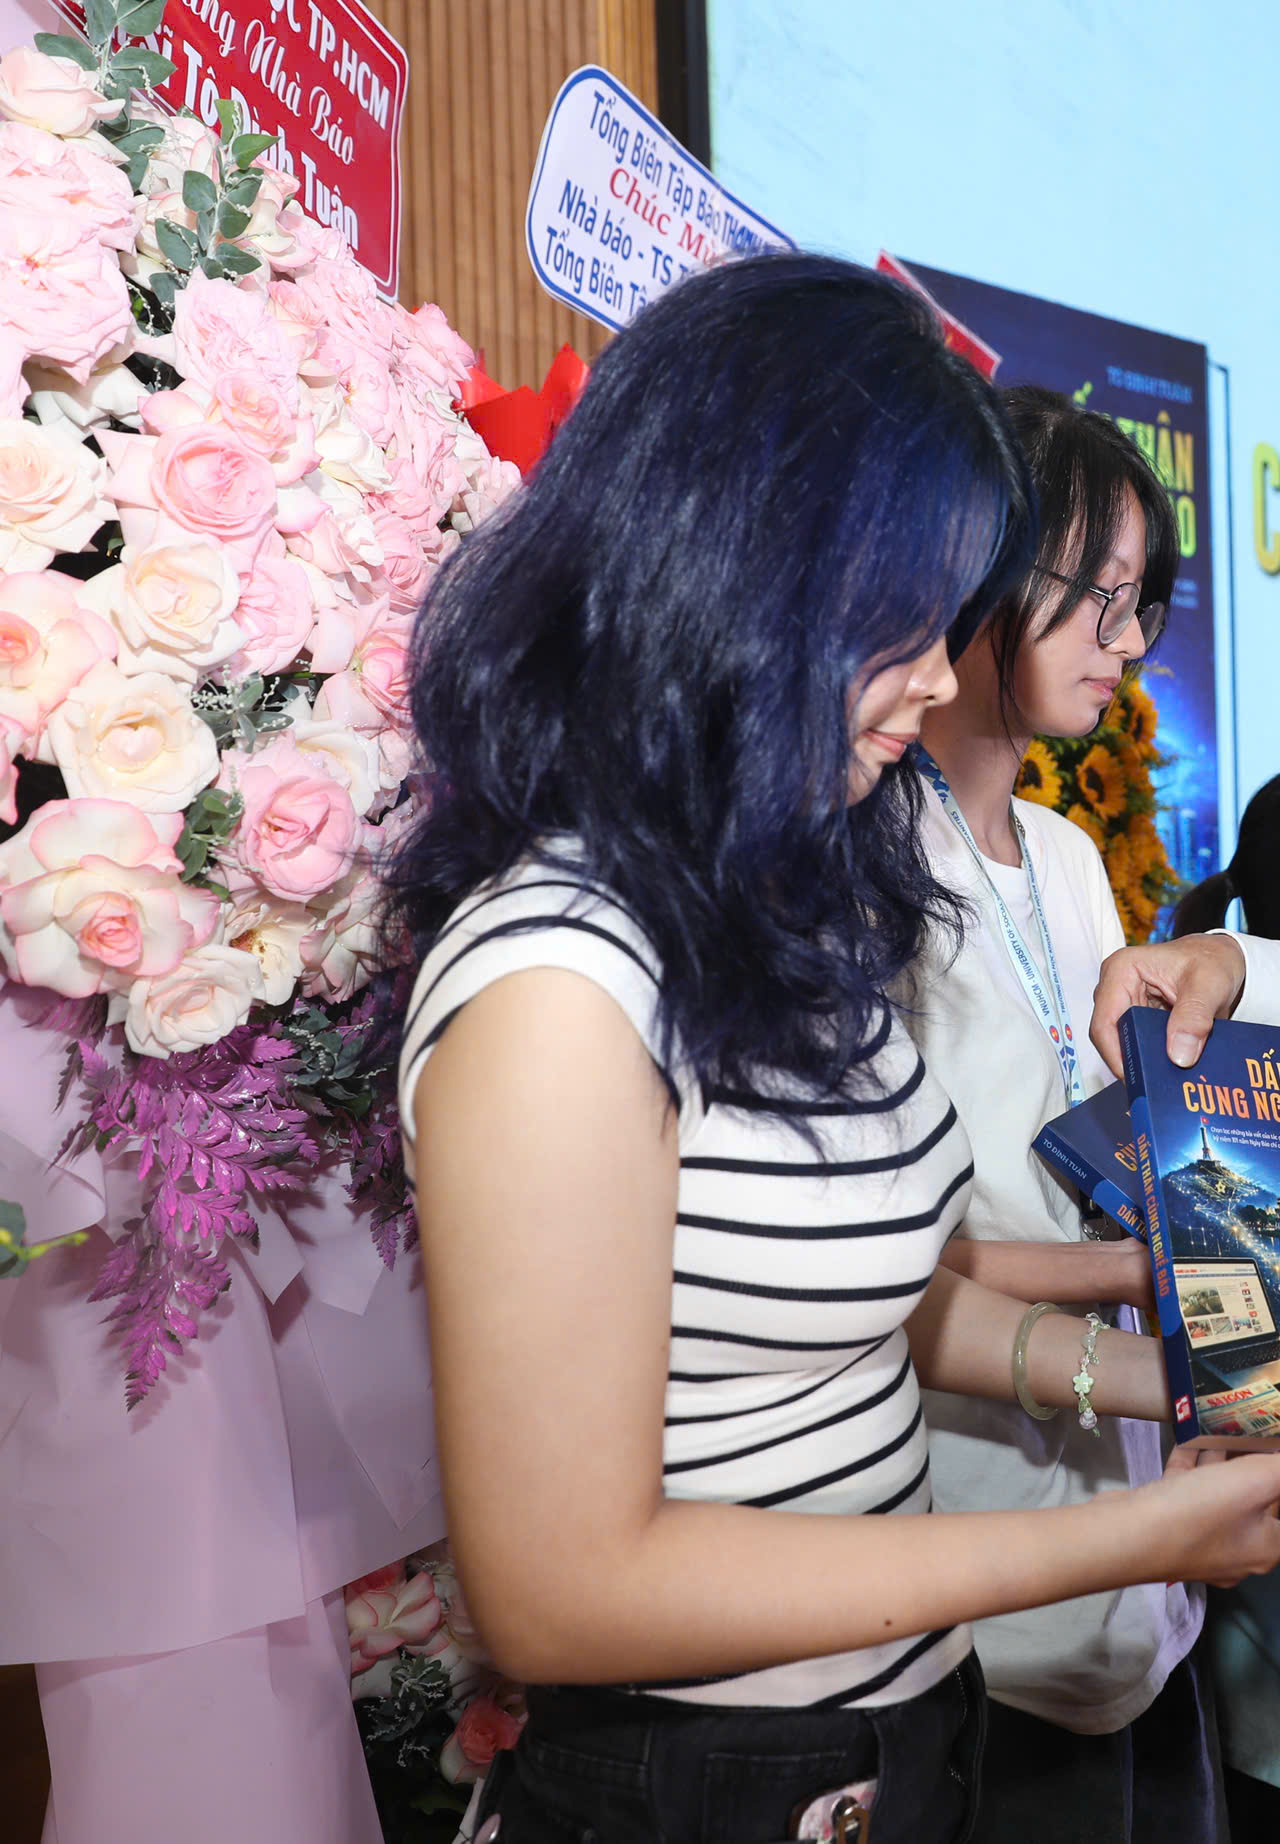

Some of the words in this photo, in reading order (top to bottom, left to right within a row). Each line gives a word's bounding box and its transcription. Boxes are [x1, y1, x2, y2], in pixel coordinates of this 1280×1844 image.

[183, 40, 220, 127] Tô
[308, 0, 390, 130] TP.HCM
[244, 20, 301, 117] Nhà
[309, 86, 355, 165] Báo
[590, 90, 629, 164] Tổng
[631, 131, 662, 188] Biên
[666, 163, 693, 217] Tập
[610, 168, 671, 235] Chúc
[559, 179, 597, 235] Nhà
[600, 210, 632, 260] báo
[652, 246, 673, 287] TS
[545, 226, 584, 294] Tổng
[590, 258, 623, 310] Biên
[1006, 928, 1015, 939] OF
[1010, 937, 1035, 980] UNIVERSITY
[1031, 983, 1051, 1016] VNUHCM
[1182, 1075, 1250, 1119] CÙNG
[1043, 1138, 1052, 1149] TÔ
[1051, 1146, 1069, 1164] ĐÌNH
[1068, 1160, 1088, 1180] TUÂN
[1137, 1133, 1151, 1161] DẤN
[1141, 1160, 1155, 1195] THÂN
[1117, 1204, 1138, 1227] DẤN
[1145, 1195, 1160, 1232] CÙNG
[1151, 1232, 1169, 1270] NGHỀ
[1157, 1270, 1171, 1297] BÁO
